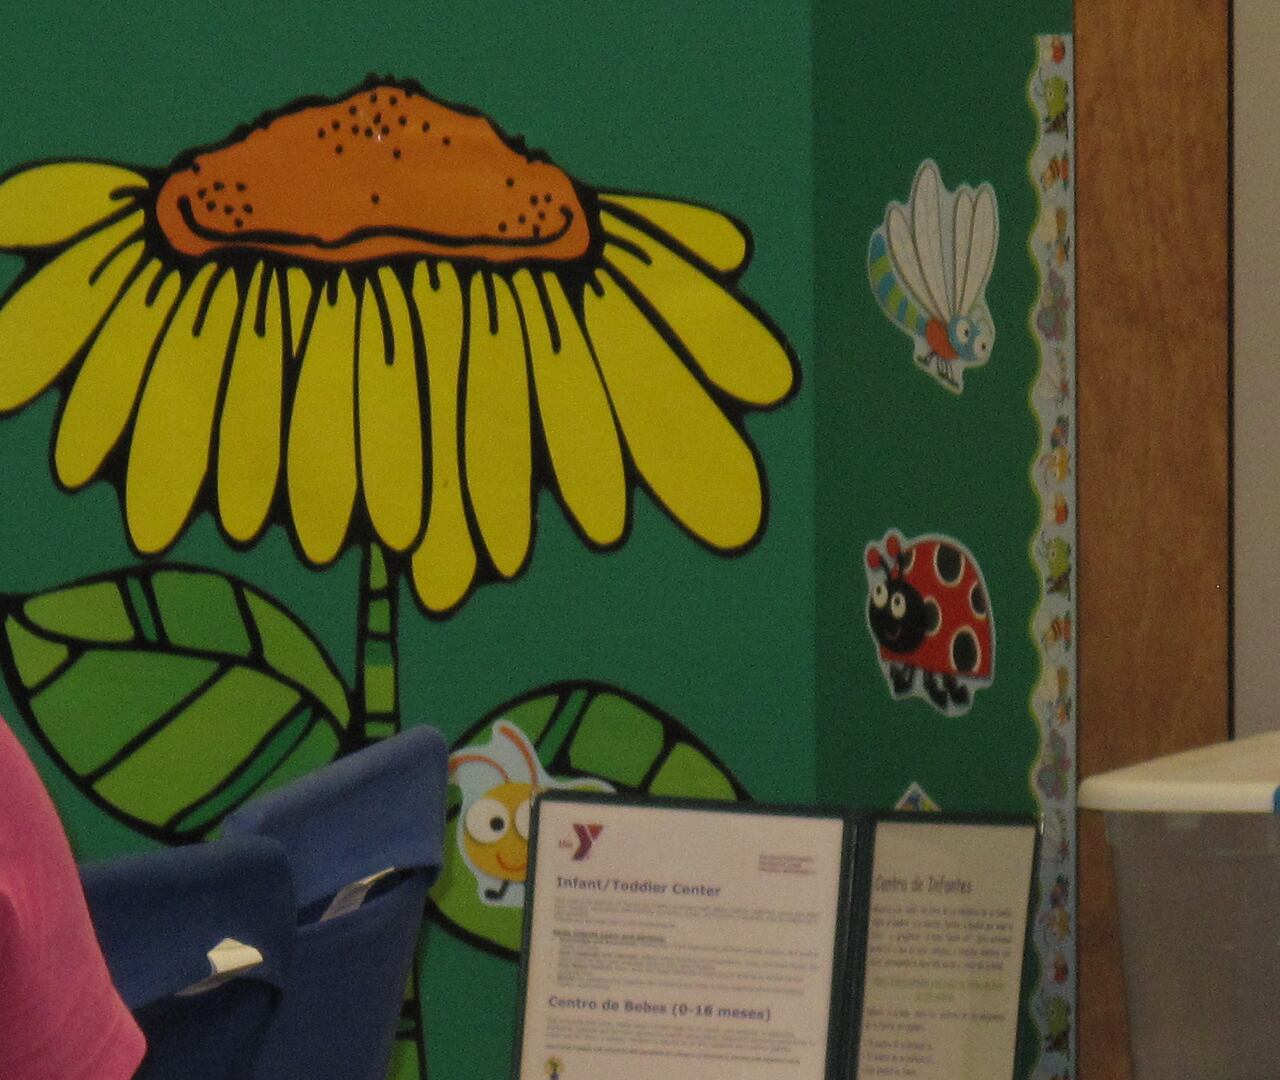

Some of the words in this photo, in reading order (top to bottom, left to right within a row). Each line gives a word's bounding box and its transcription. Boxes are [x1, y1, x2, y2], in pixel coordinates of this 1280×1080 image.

[556, 876, 668, 895] Infant/Toddler
[672, 881, 722, 898] Center
[548, 994, 598, 1011] Centro
[602, 998, 620, 1012] de
[623, 999, 668, 1015] Bebes
[717, 1005, 772, 1022] meses)
